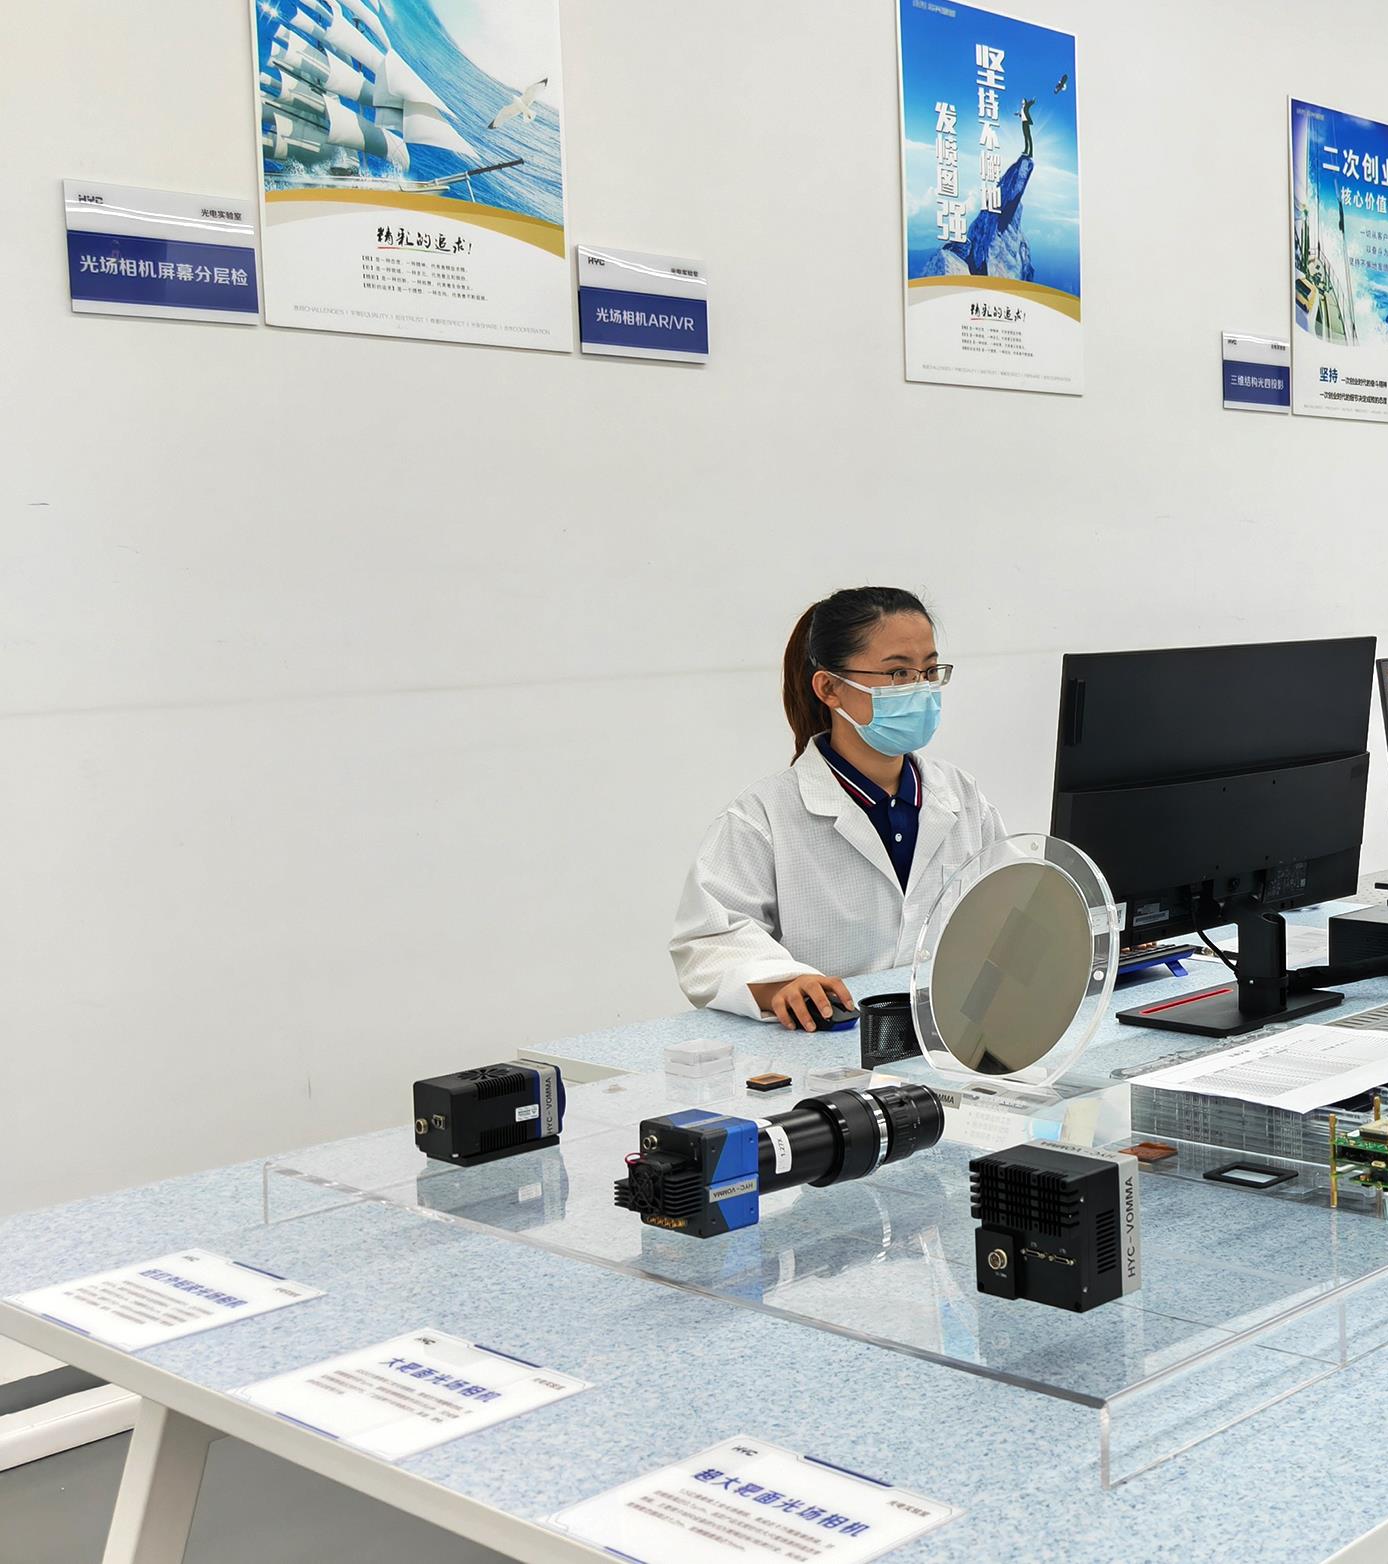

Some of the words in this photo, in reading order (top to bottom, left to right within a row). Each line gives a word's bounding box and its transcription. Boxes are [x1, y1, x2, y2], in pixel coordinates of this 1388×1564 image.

[934, 101, 968, 243] 发愤图强
[201, 208, 242, 221] 光电实验室
[79, 255, 249, 287] 光场相机屏幕分层检
[596, 307, 695, 331] 光场相机AR/VR
[1319, 366, 1338, 384] 坚持
[1124, 1176, 1134, 1235] VOMMA
[1127, 1245, 1136, 1278] HYC
[691, 1467, 871, 1538] 超大靶面光场相机
